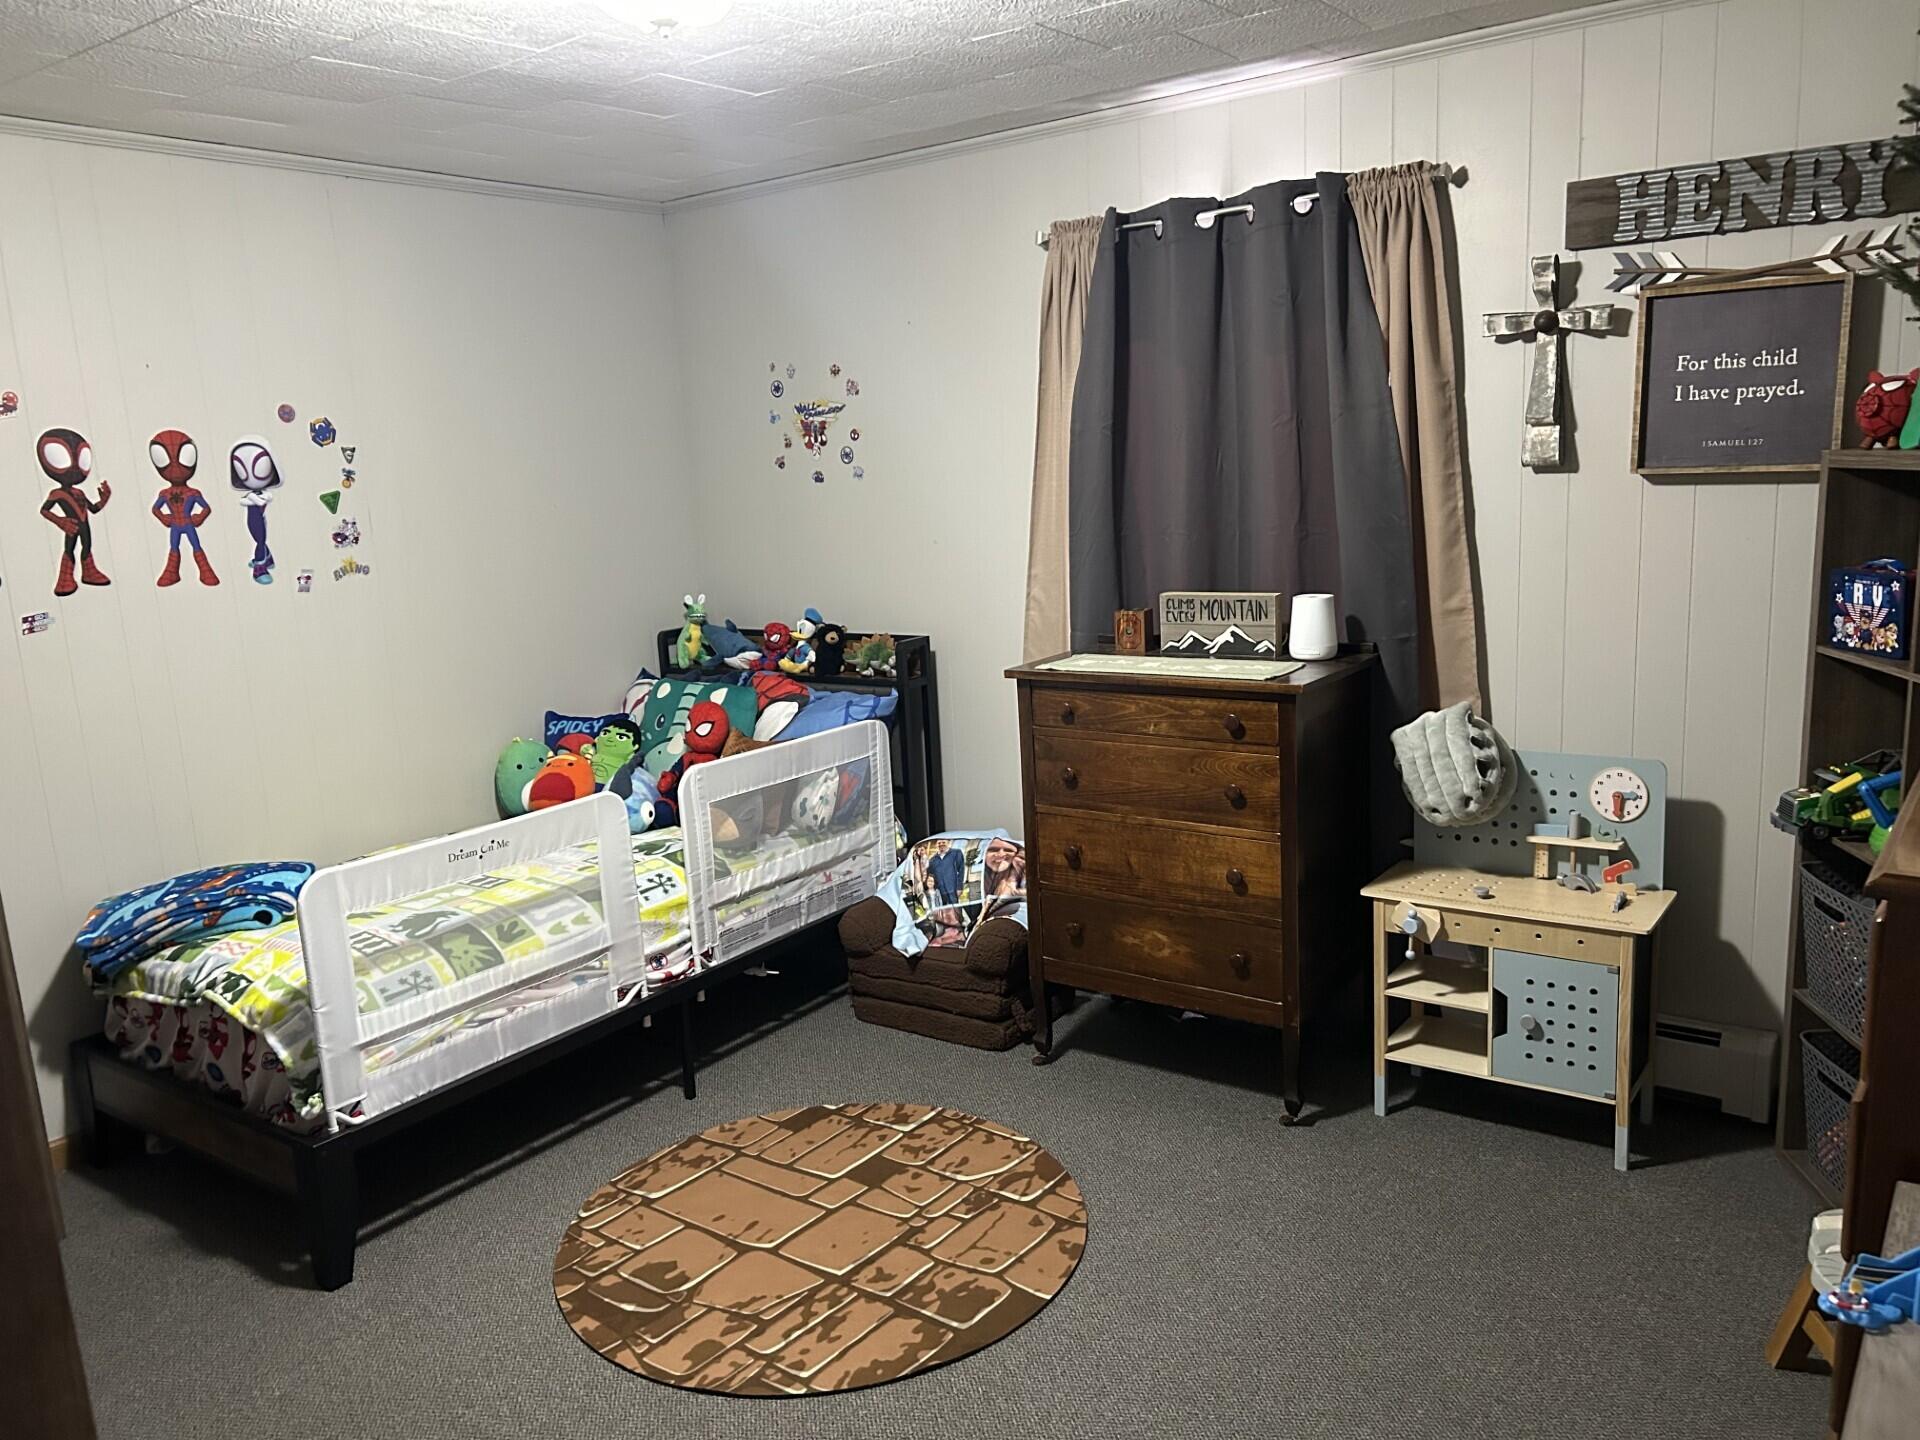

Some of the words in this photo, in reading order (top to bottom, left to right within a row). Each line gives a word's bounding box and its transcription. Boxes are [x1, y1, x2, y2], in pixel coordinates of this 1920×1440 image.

[1613, 142, 1900, 242] HENRY
[1676, 354, 1709, 372] For
[1713, 352, 1746, 369] this
[1752, 348, 1798, 367] child
[1675, 385, 1682, 402] I
[1688, 384, 1729, 401] have
[1734, 378, 1805, 405] prayed.
[1707, 439, 1745, 447] SAMUEL
[1165, 598, 1196, 610] CLIMB
[1199, 598, 1268, 621] MOUNTAIN
[1165, 611, 1196, 622] EVERY
[546, 718, 604, 736] SPIDEY
[447, 848, 478, 863] Dream
[496, 839, 510, 850] Me
